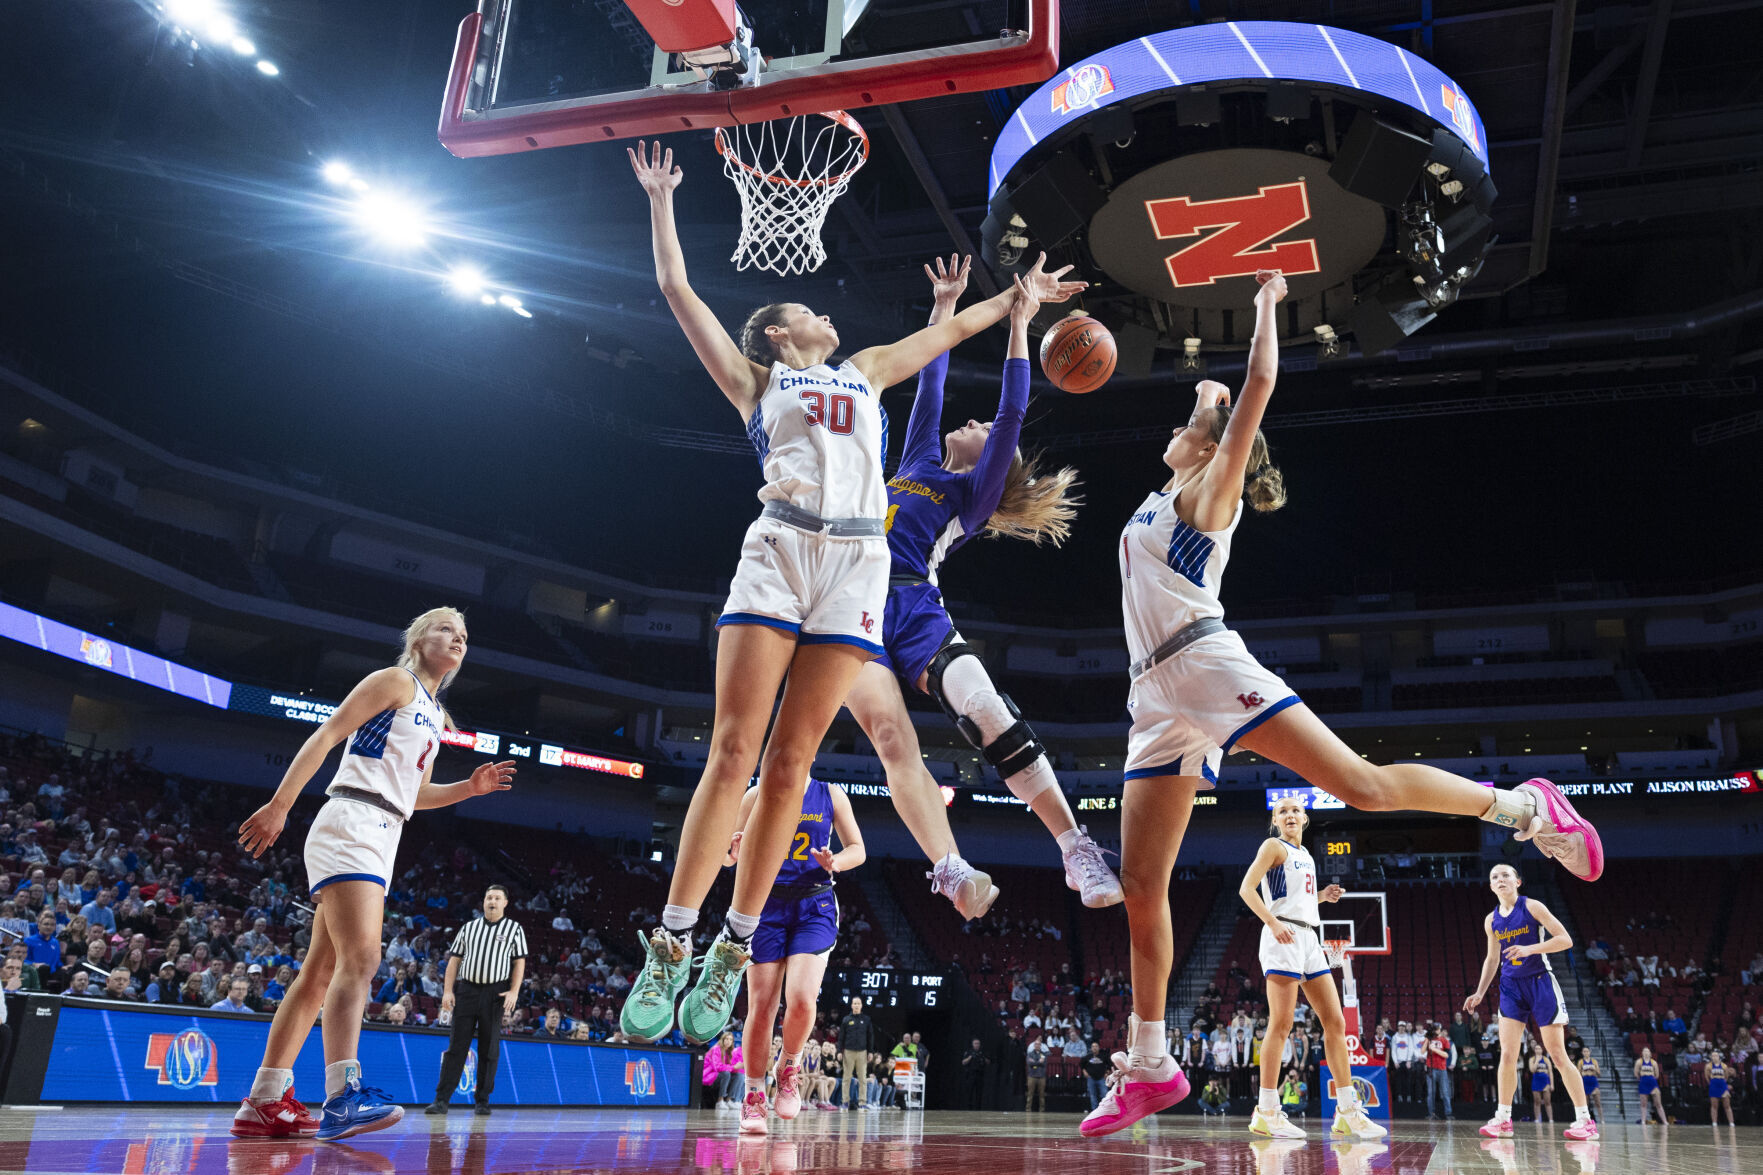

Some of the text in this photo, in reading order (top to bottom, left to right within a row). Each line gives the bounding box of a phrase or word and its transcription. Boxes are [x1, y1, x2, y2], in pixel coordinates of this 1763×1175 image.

[1144, 181, 1321, 288] N
[799, 390, 856, 436] 30
[270, 695, 337, 715] DEVANEY SCO
[285, 708, 318, 722] CLASS
[508, 743, 531, 757] 2nd
[1592, 782, 1634, 795] PLANT
[1647, 781, 1695, 793] ALISON
[1697, 776, 1751, 792] KRAUSS
[1077, 796, 1117, 810] JUNE 5
[1327, 842, 1351, 855] 3:07
[861, 972, 889, 988] 3:07
[921, 976, 943, 987] PORT
[924, 990, 937, 1006] 15
